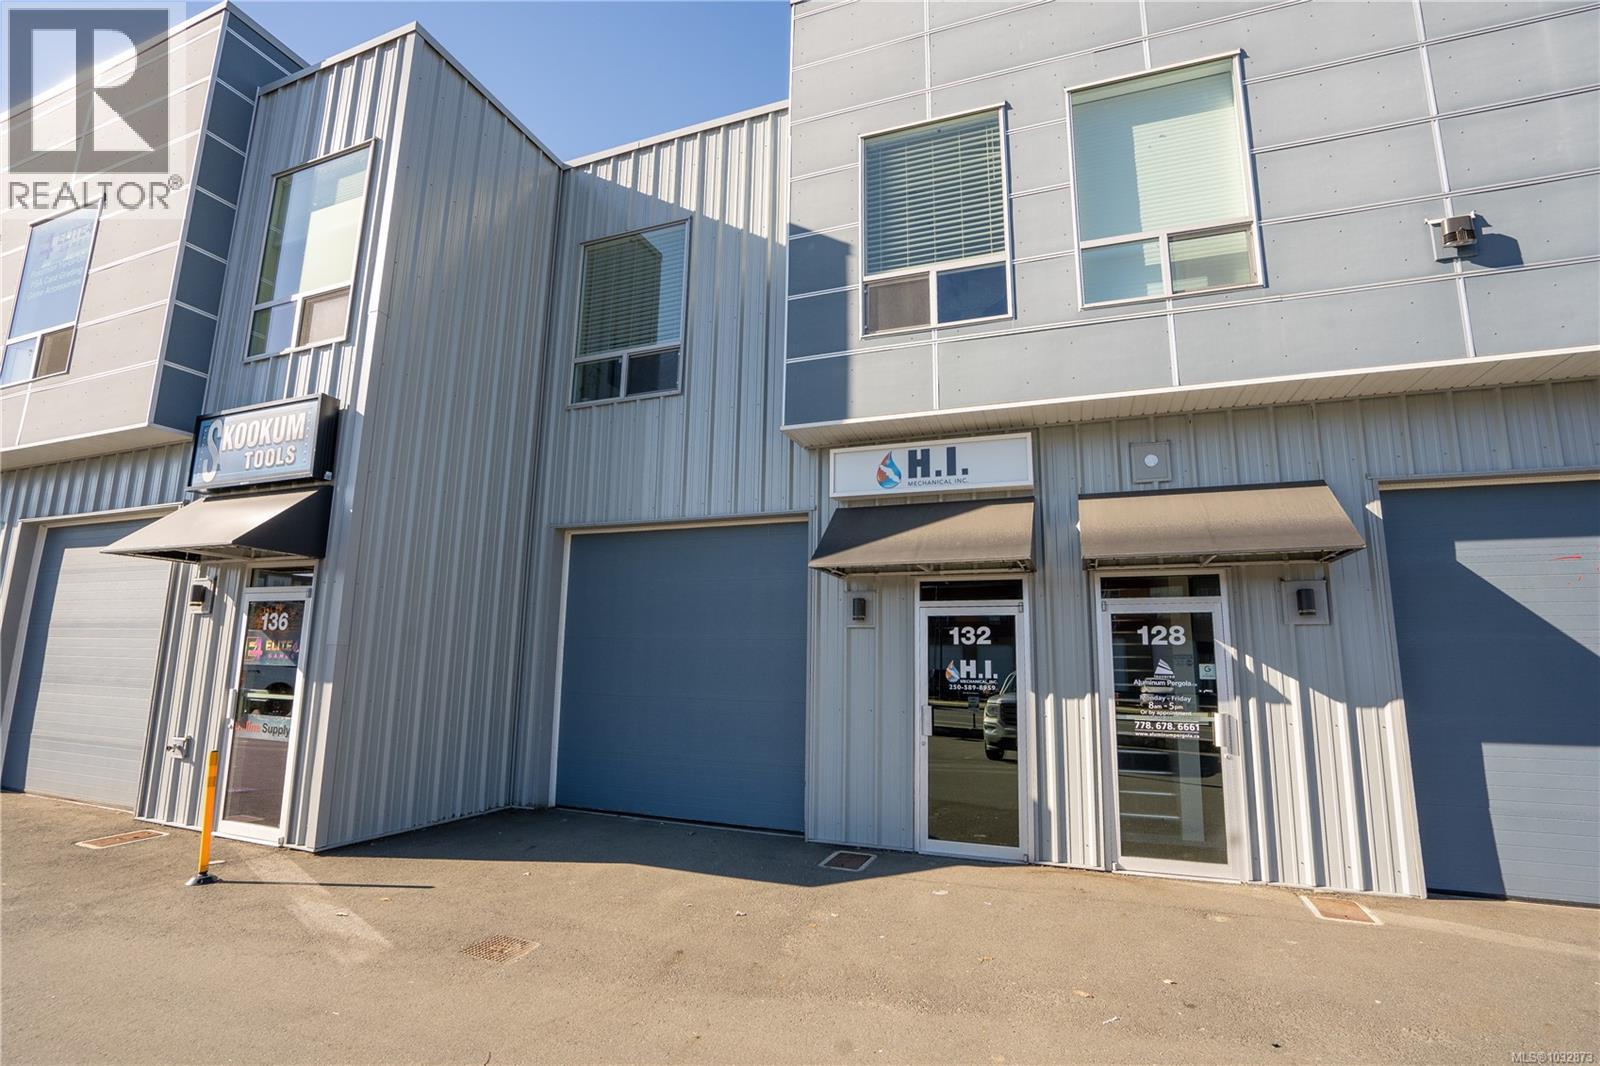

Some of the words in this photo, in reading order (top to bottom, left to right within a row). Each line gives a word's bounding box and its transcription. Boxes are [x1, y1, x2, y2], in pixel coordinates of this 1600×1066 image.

[202, 412, 306, 482] SKOOKUM
[244, 445, 296, 470] TOOLS
[908, 446, 969, 478] H.I.
[907, 478, 953, 487] MECHANICAL
[262, 612, 289, 631] 136
[949, 626, 992, 645] 132
[1137, 625, 1186, 645] 128
[960, 659, 998, 679] H.I.
[1133, 679, 1166, 687] Aluminum
[1140, 694, 1165, 702] Monday
[1172, 695, 1192, 703] Friday
[1148, 701, 1163, 709] 8am
[1169, 702, 1184, 711] 5pm
[1177, 723, 1199, 731] 6661
